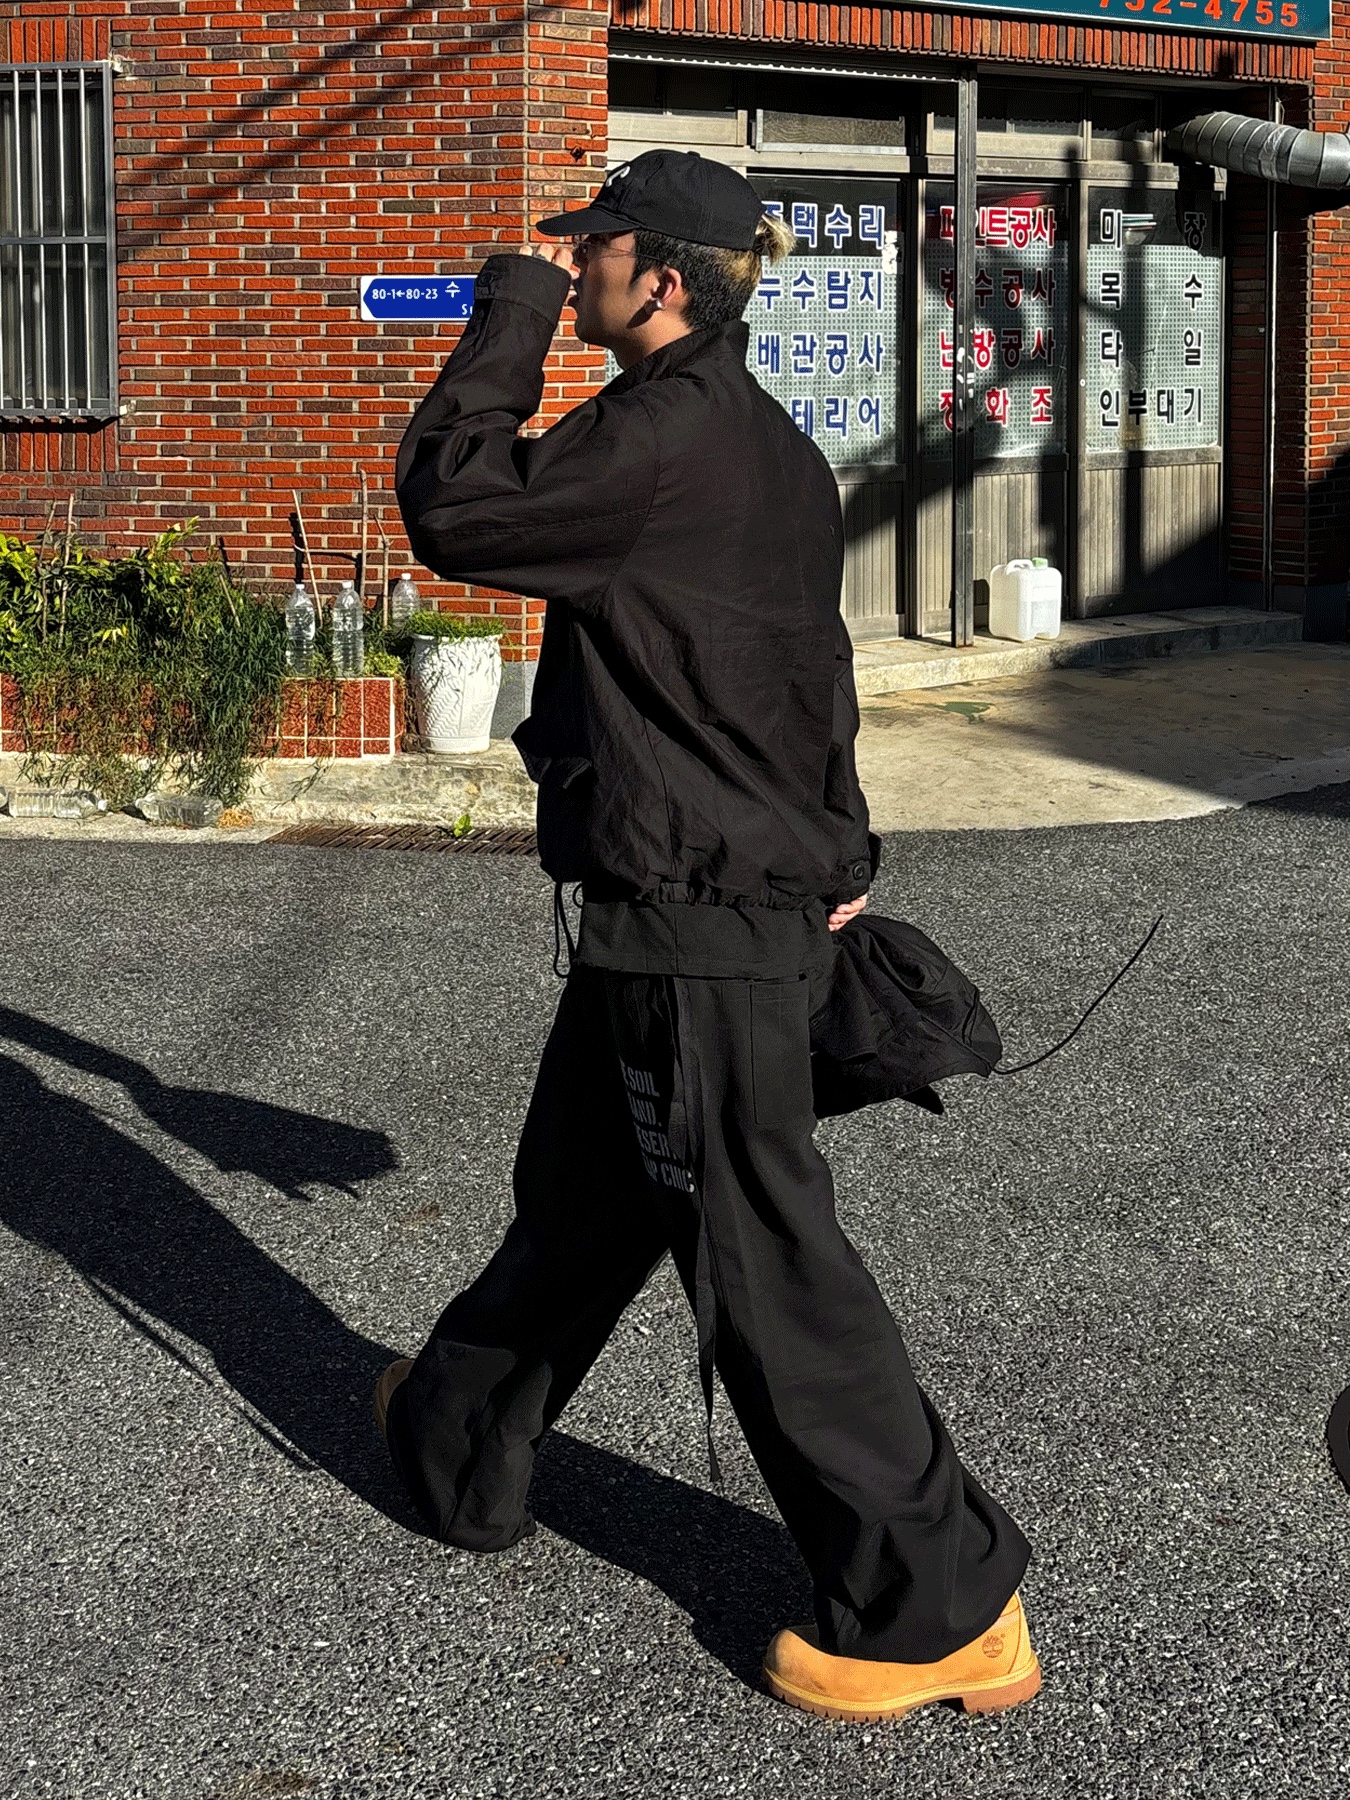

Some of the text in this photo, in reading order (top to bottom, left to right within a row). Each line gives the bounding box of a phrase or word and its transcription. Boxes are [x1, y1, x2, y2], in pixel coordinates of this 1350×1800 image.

[757, 270, 884, 311] 누수탐지
[757, 333, 884, 375] 배관공사
[790, 397, 881, 438] 테리어
[1100, 389, 1203, 428] 인부대기
